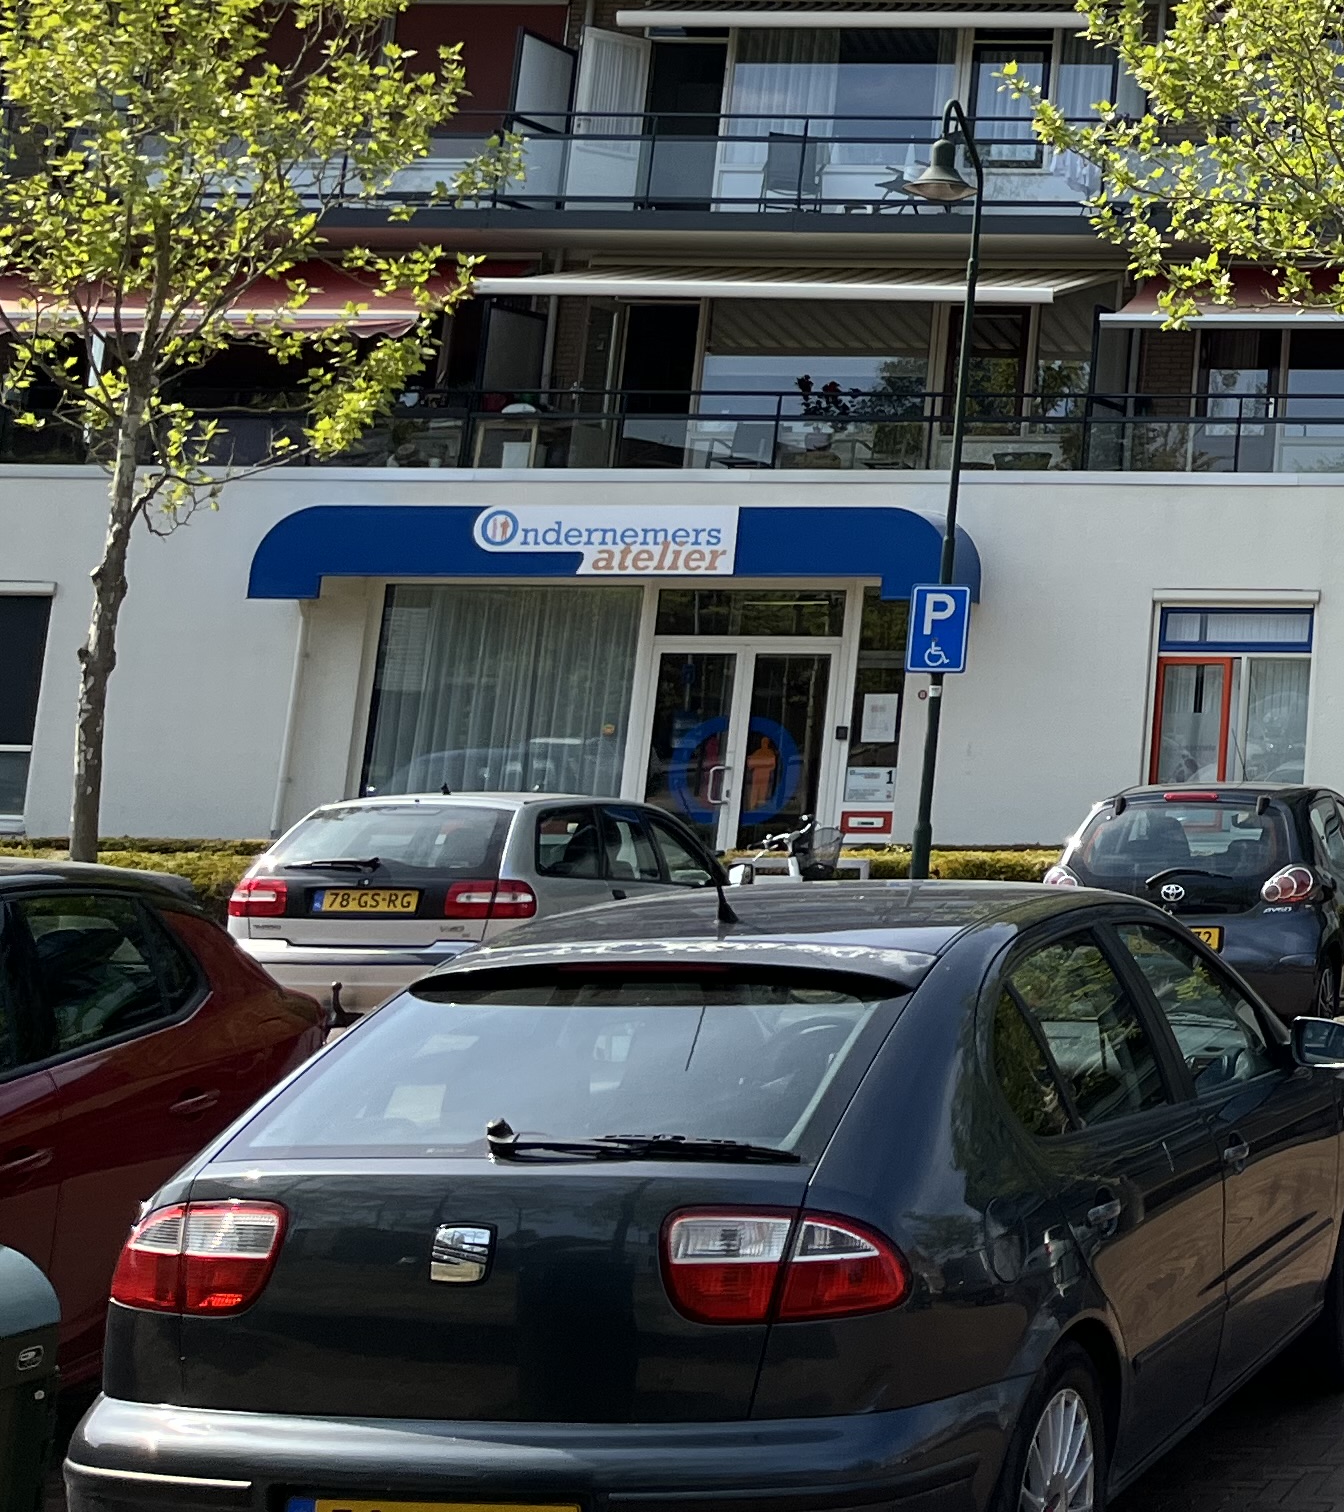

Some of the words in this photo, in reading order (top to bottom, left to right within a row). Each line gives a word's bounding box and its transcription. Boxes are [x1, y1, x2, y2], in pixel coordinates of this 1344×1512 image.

[481, 509, 722, 546] Ondernemers
[592, 540, 727, 571] atelier
[923, 593, 956, 635] P
[886, 770, 894, 785] 1
[328, 892, 412, 908] 78-GS-RG
